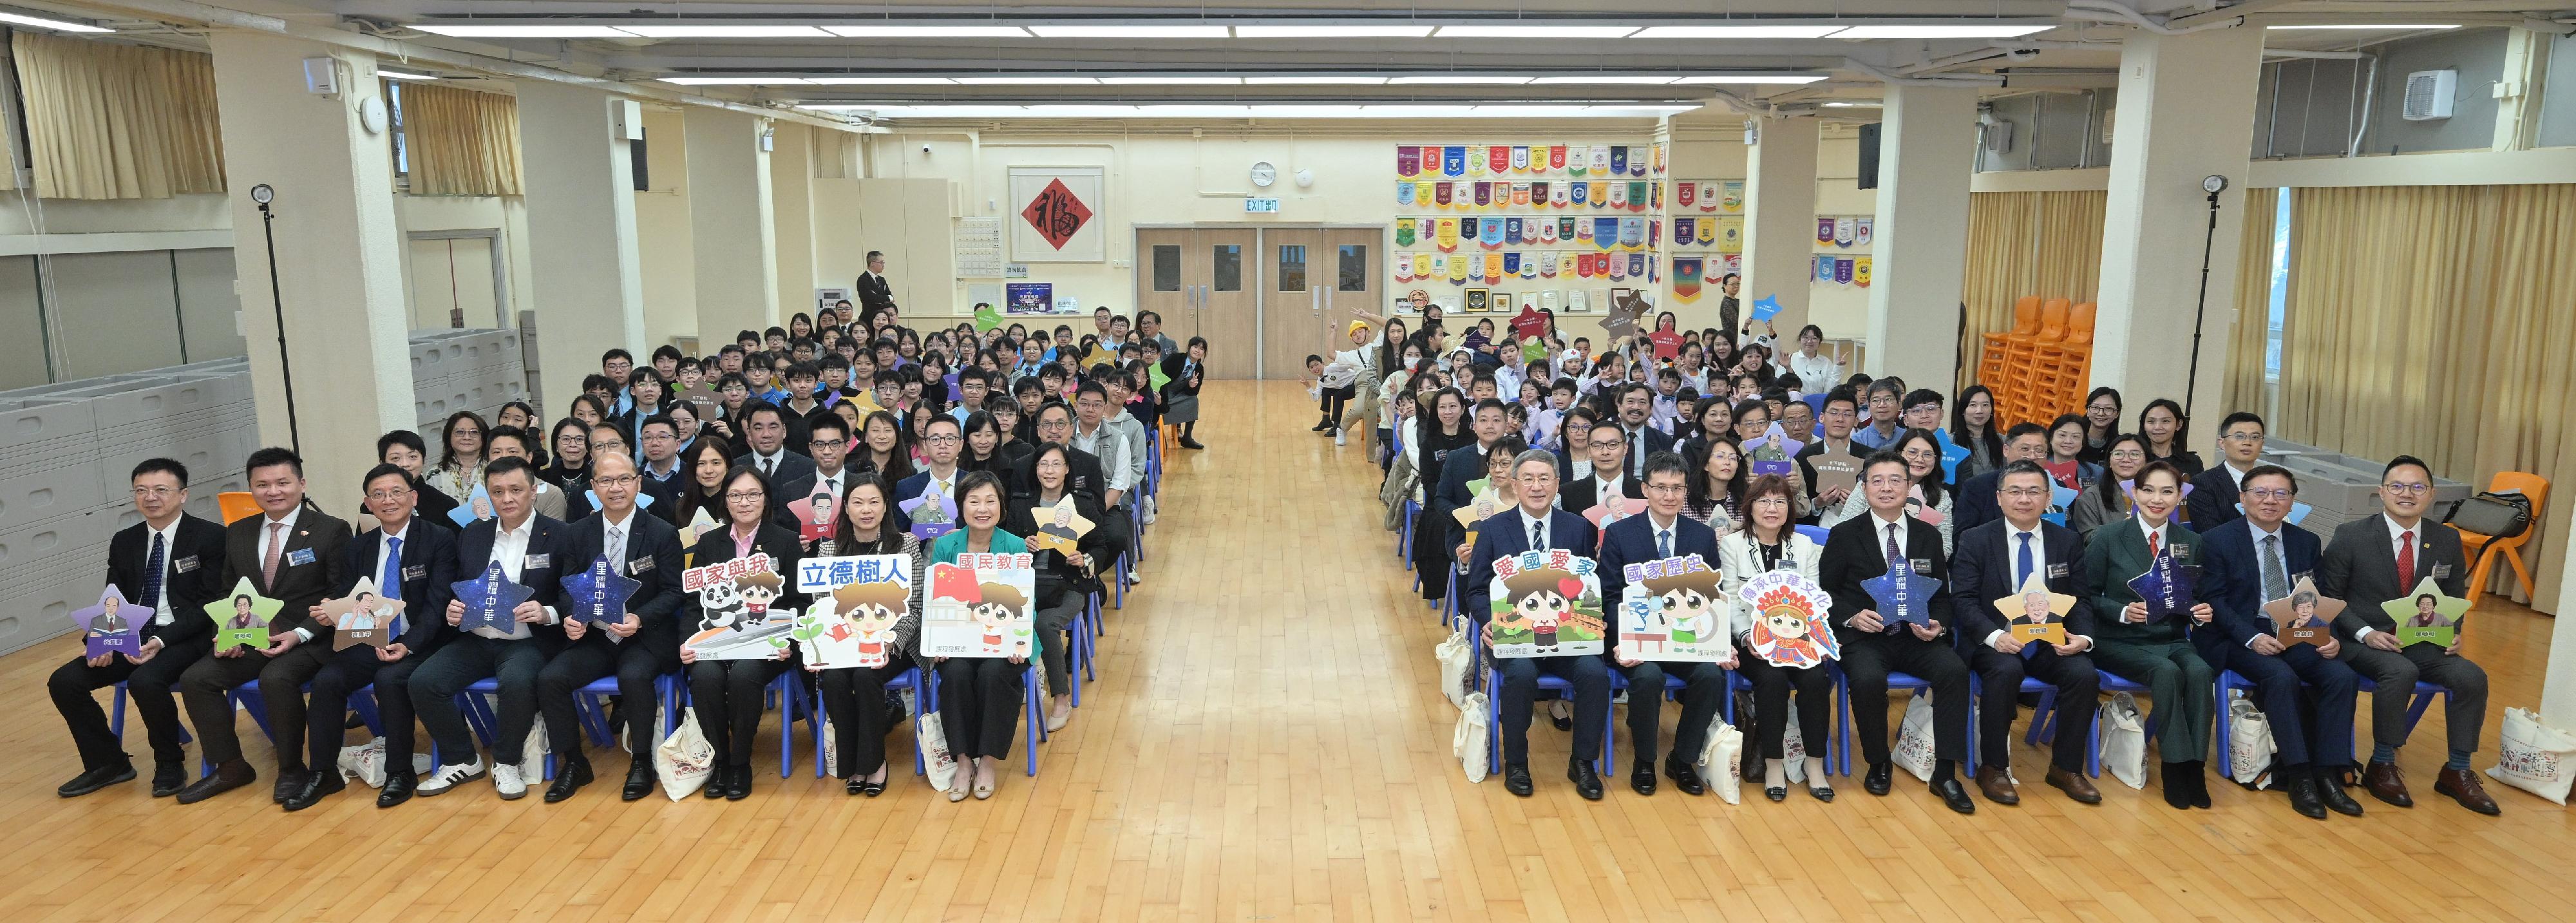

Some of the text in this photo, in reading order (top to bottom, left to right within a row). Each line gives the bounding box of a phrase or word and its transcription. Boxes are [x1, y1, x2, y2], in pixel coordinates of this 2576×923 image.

[1035, 189, 1079, 240] 福
[1247, 200, 1277, 211] EXIT 出口
[684, 554, 770, 590] 國家與我
[802, 558, 909, 587] 立德樹人
[959, 553, 1031, 569] 國民教育
[1495, 549, 1596, 580] 愛國愛家
[1625, 554, 1704, 583] 國家歷史
[484, 568, 500, 622] 星耀中華
[593, 561, 607, 616] 星耀中華
[1741, 572, 1830, 609] 傳承中華文化
[1895, 563, 1908, 617] 星耀中華
[2159, 556, 2175, 609] 星耀中華
